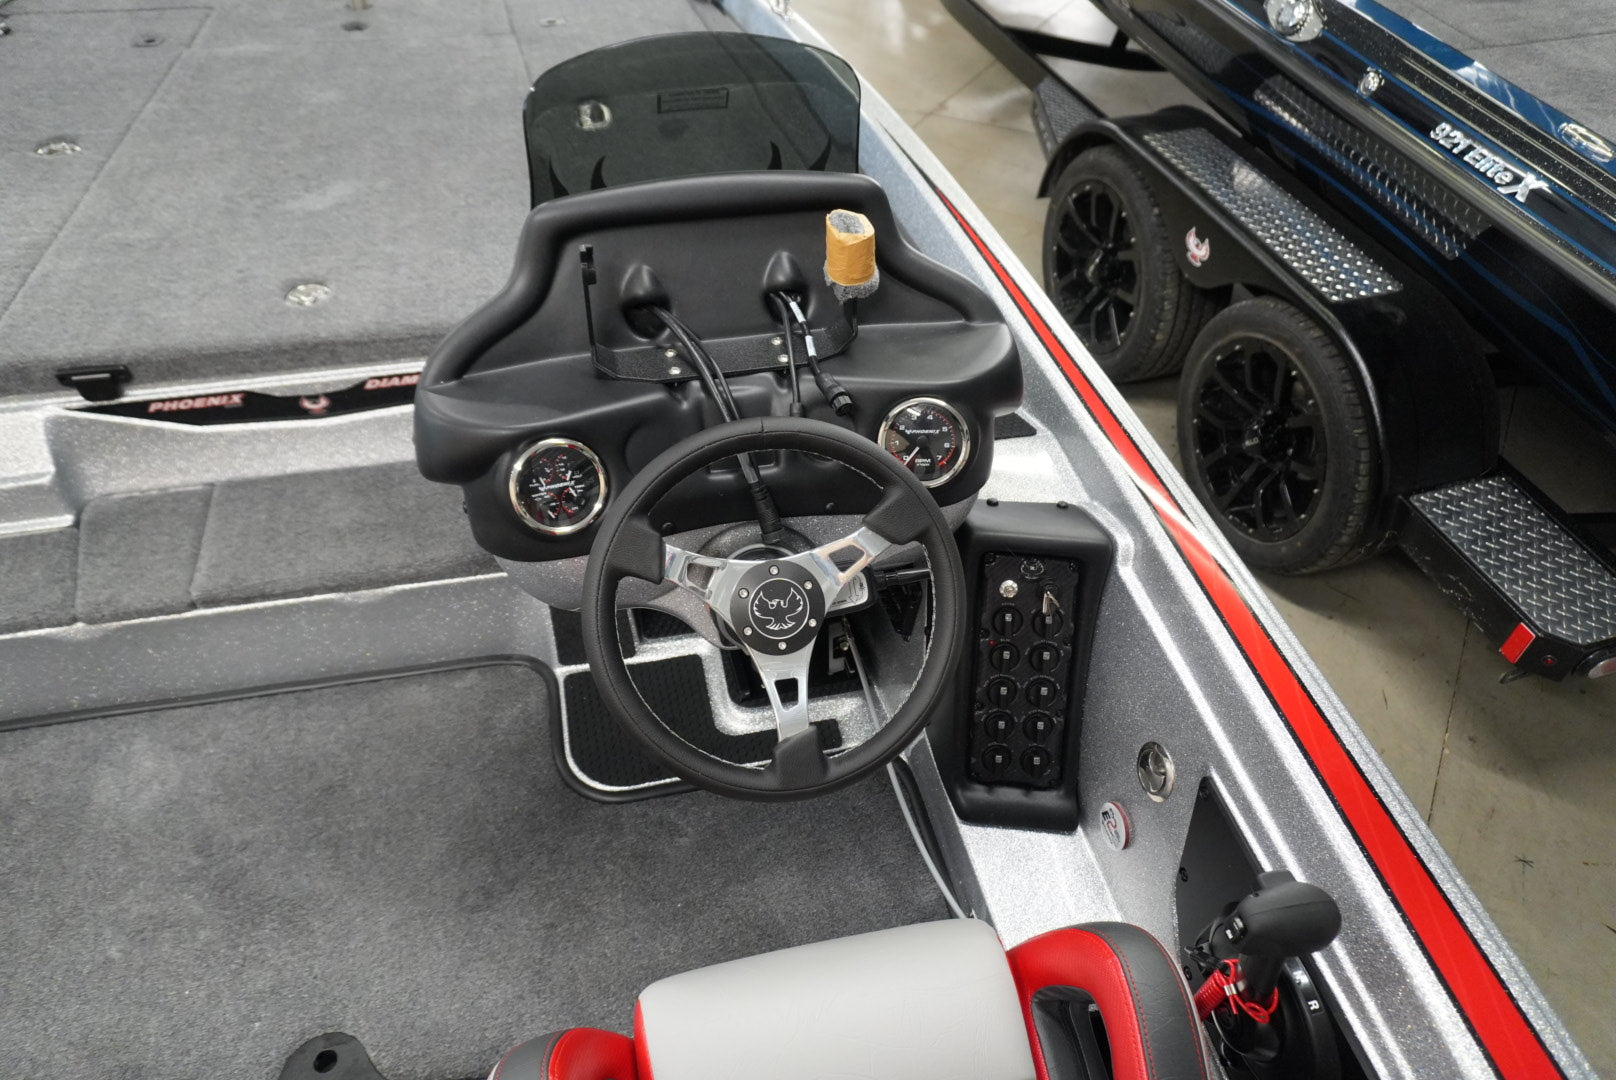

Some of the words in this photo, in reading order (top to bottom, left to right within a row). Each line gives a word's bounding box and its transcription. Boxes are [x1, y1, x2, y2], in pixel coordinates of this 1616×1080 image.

[1430, 122, 1473, 154] 921
[148, 393, 246, 413] PHOENIX
[1307, 999, 1320, 1012] R
